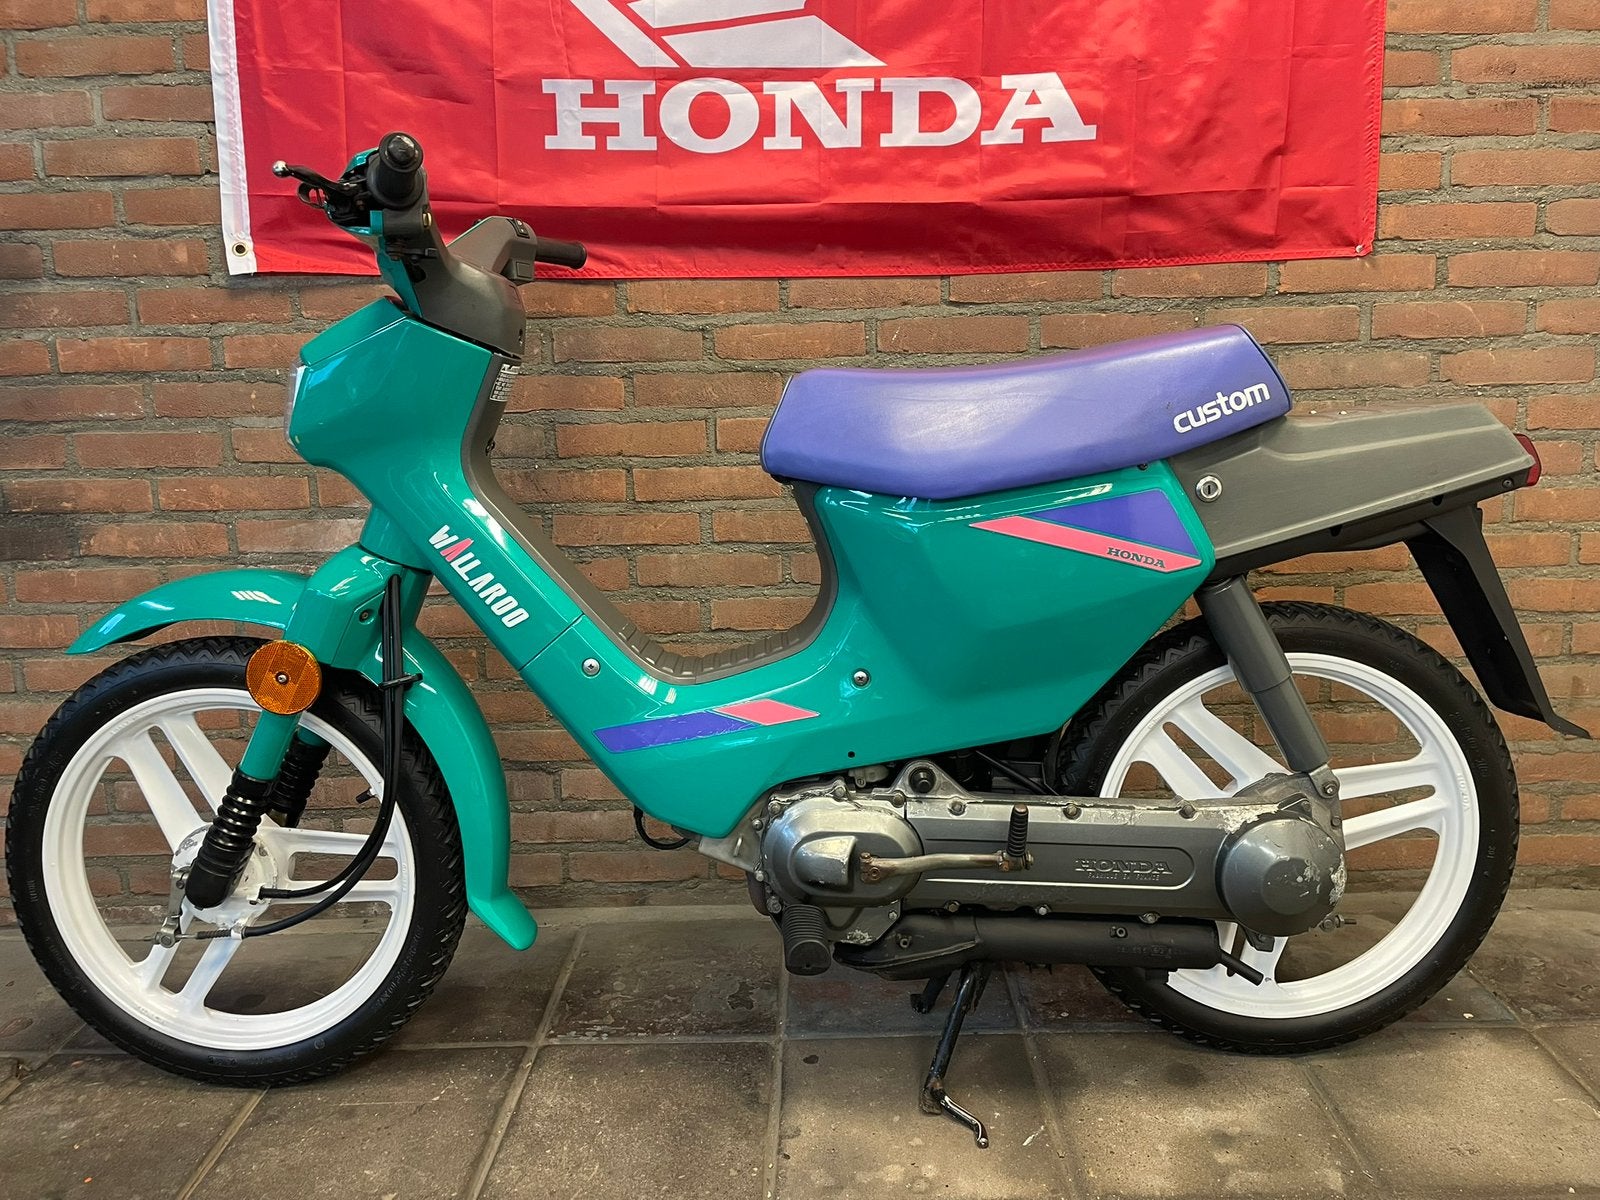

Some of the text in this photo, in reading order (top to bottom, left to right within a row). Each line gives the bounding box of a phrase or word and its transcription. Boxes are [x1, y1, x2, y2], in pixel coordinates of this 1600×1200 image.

[541, 71, 1097, 154] HONDA
[1173, 383, 1271, 433] custom
[428, 524, 530, 628] WALLAROO
[1106, 547, 1166, 568] HONDA
[1074, 859, 1173, 874] HONDA
